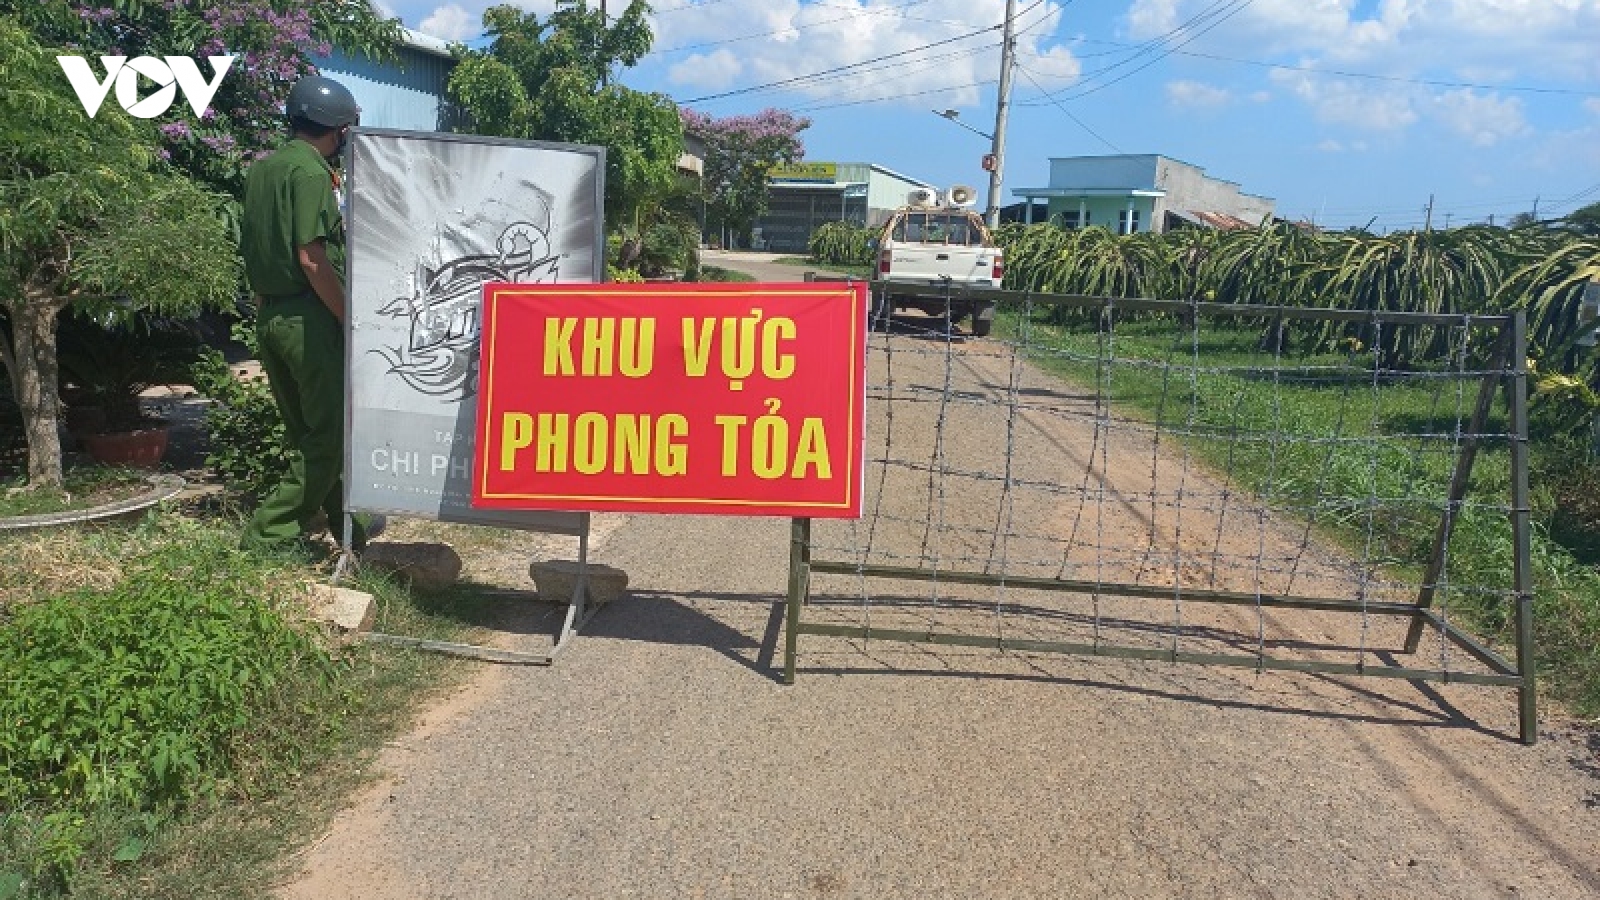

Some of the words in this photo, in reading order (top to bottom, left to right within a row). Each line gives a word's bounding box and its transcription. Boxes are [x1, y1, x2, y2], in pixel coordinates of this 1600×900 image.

[543, 317, 656, 378] KHU
[681, 308, 797, 391] VỰC
[372, 449, 419, 475] CHI
[500, 411, 689, 477] PHONG
[715, 397, 833, 479] TỎA
